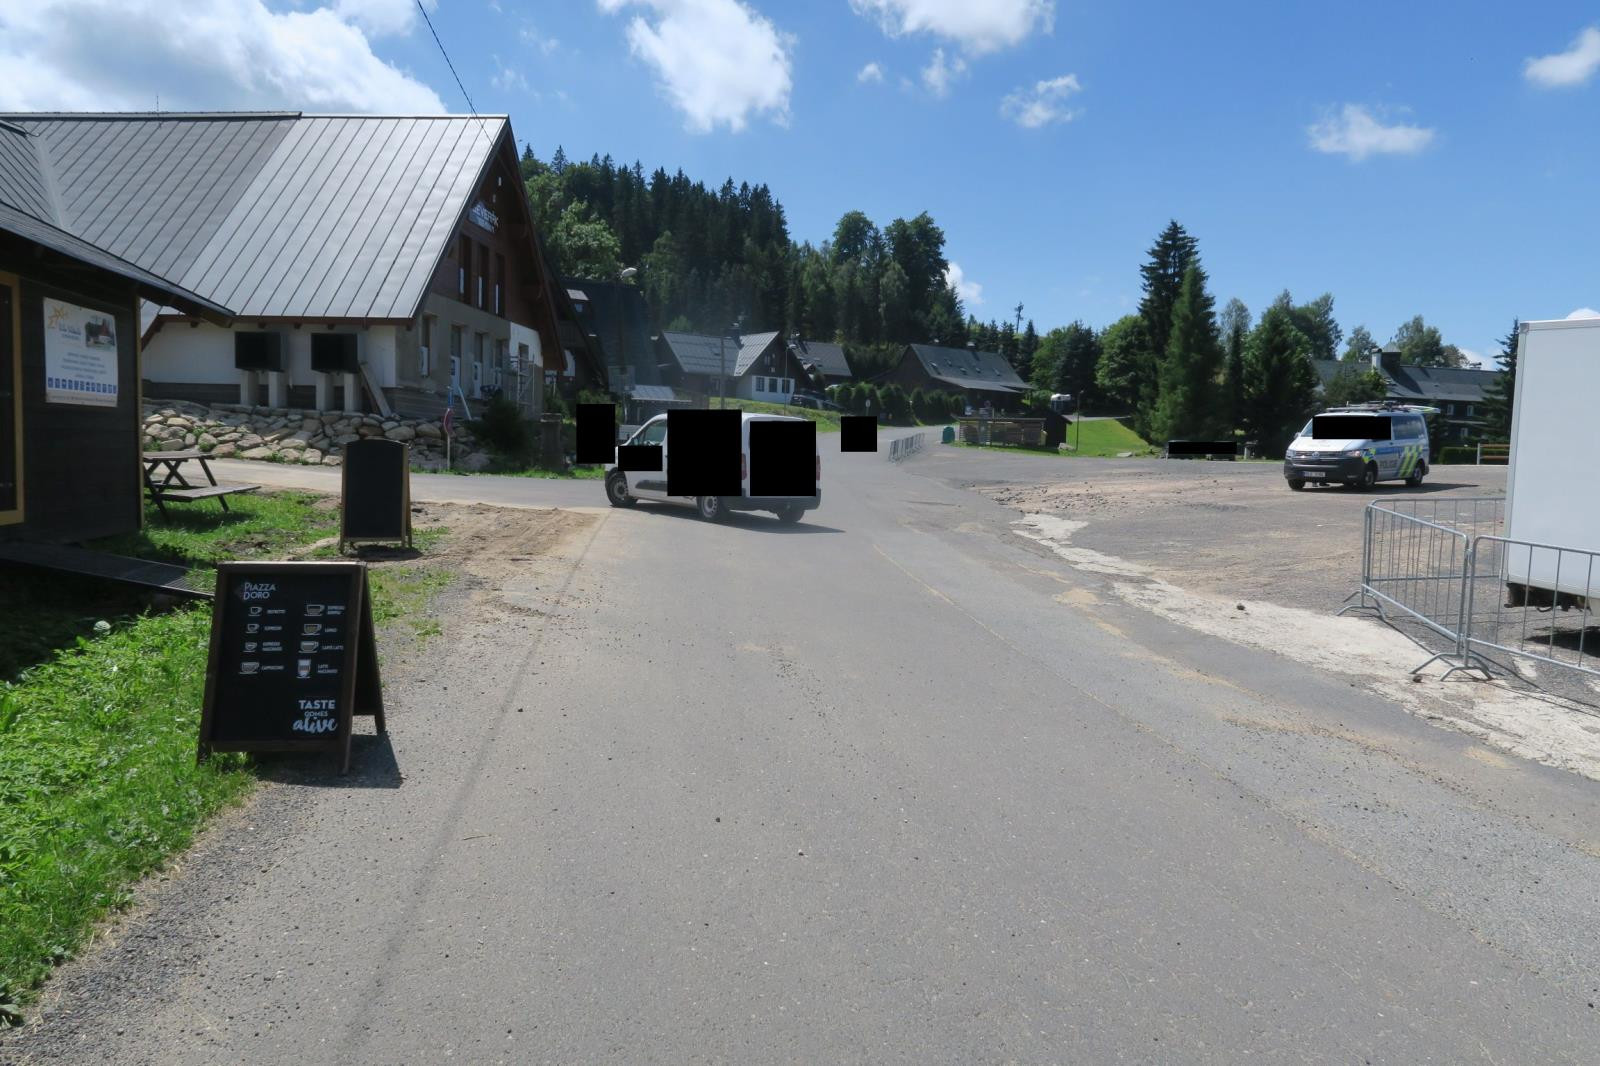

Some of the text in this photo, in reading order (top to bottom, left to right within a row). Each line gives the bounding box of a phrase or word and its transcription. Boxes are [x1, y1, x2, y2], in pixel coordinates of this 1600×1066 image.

[244, 582, 276, 592] PIAZZA
[243, 591, 270, 600] DORO
[298, 699, 336, 710] TASTE
[292, 716, 338, 734] alive
